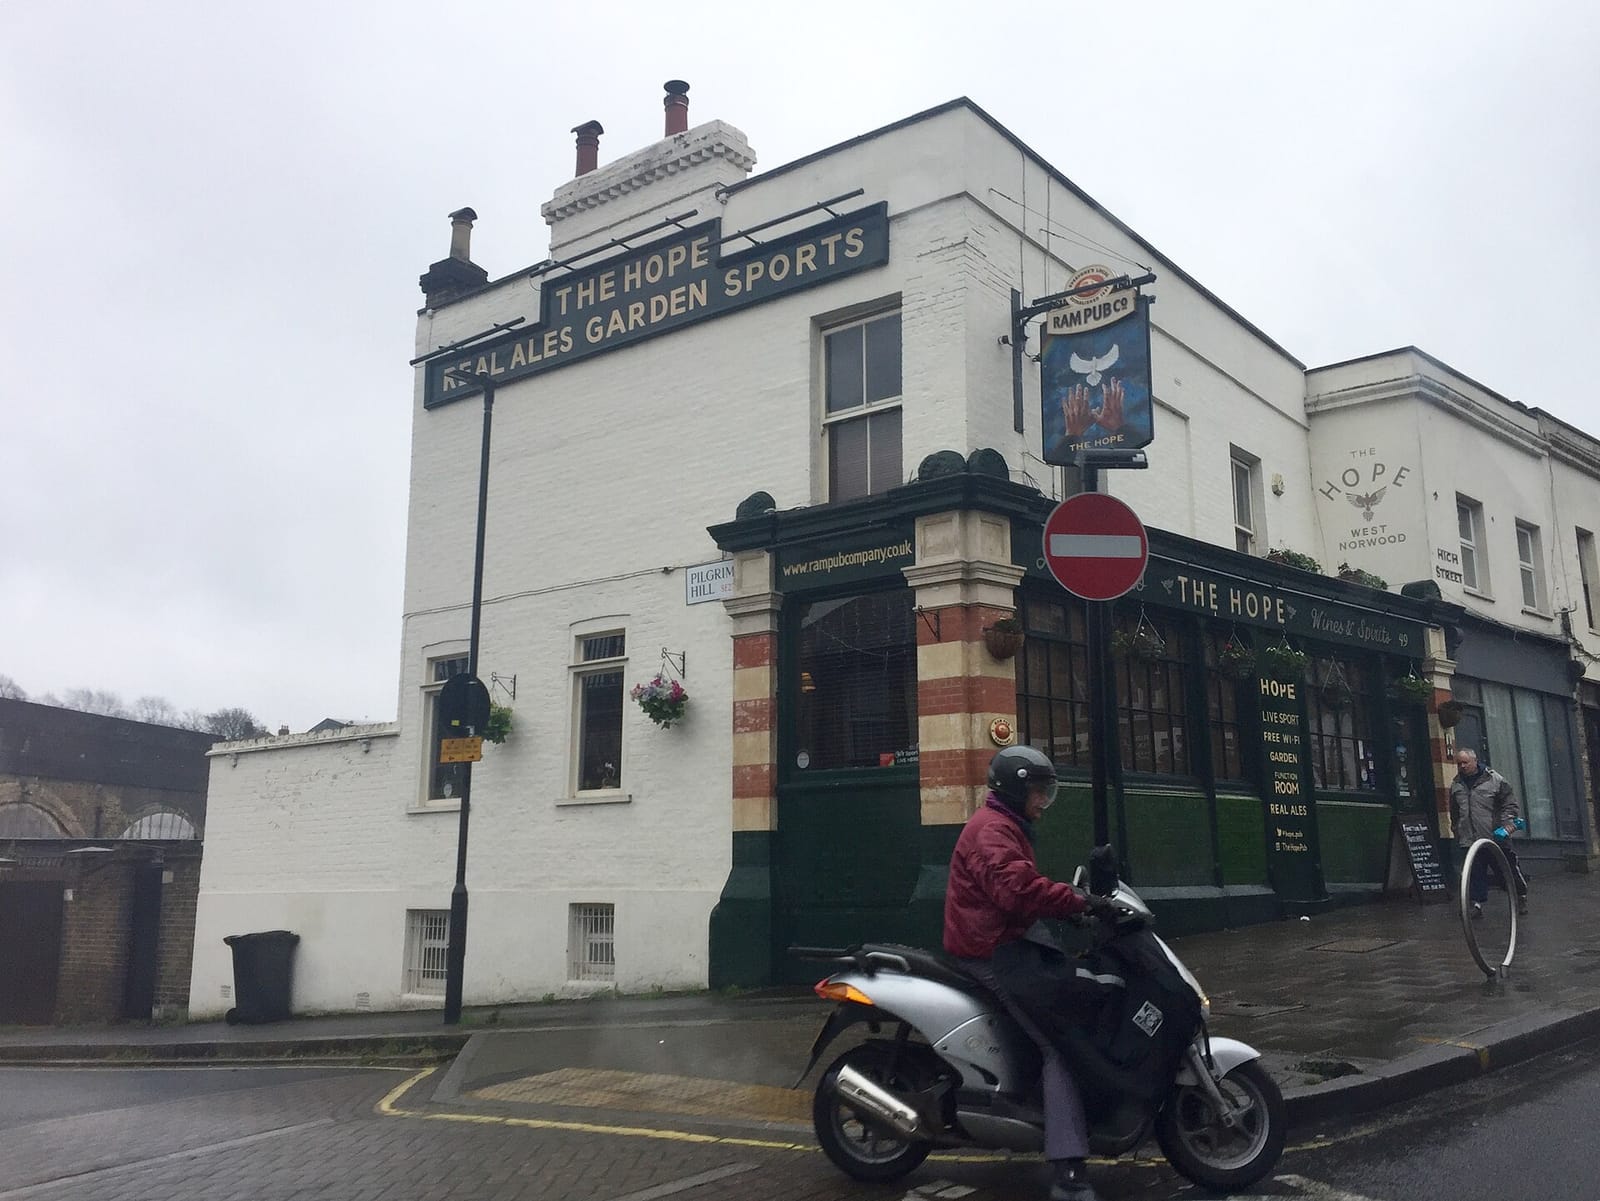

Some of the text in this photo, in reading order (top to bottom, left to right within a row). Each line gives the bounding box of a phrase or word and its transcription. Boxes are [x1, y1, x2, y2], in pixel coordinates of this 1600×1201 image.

[556, 235, 710, 316] THE HOPE
[443, 227, 865, 392] REAL ALES GARDEN SPORTS
[1053, 311, 1081, 329] RAM
[1084, 302, 1112, 324] PUB
[1069, 434, 1125, 452] THE HOPE
[1350, 447, 1377, 459] THE
[1319, 463, 1411, 501] HOPE
[1351, 524, 1388, 538] WEST
[1339, 533, 1407, 551] NORWOOD
[782, 540, 913, 576] www.rampubcompany.co.uk
[691, 565, 735, 585] PILGRIM
[1436, 565, 1463, 584] STREET
[691, 583, 715, 598] HILL
[1178, 575, 1218, 610] THE
[1230, 588, 1285, 624] HOPE
[1311, 608, 1344, 636] Wines
[1357, 619, 1392, 644] Spirits
[1260, 678, 1296, 700] HOPE
[1262, 710, 1300, 726] LIVE SPORT
[1263, 731, 1280, 743] FREE
[1270, 751, 1298, 764] GARDEN
[1274, 771, 1298, 780] FUNCTION
[1275, 781, 1300, 795] ROOM
[1270, 803, 1307, 816] REAL ALES
